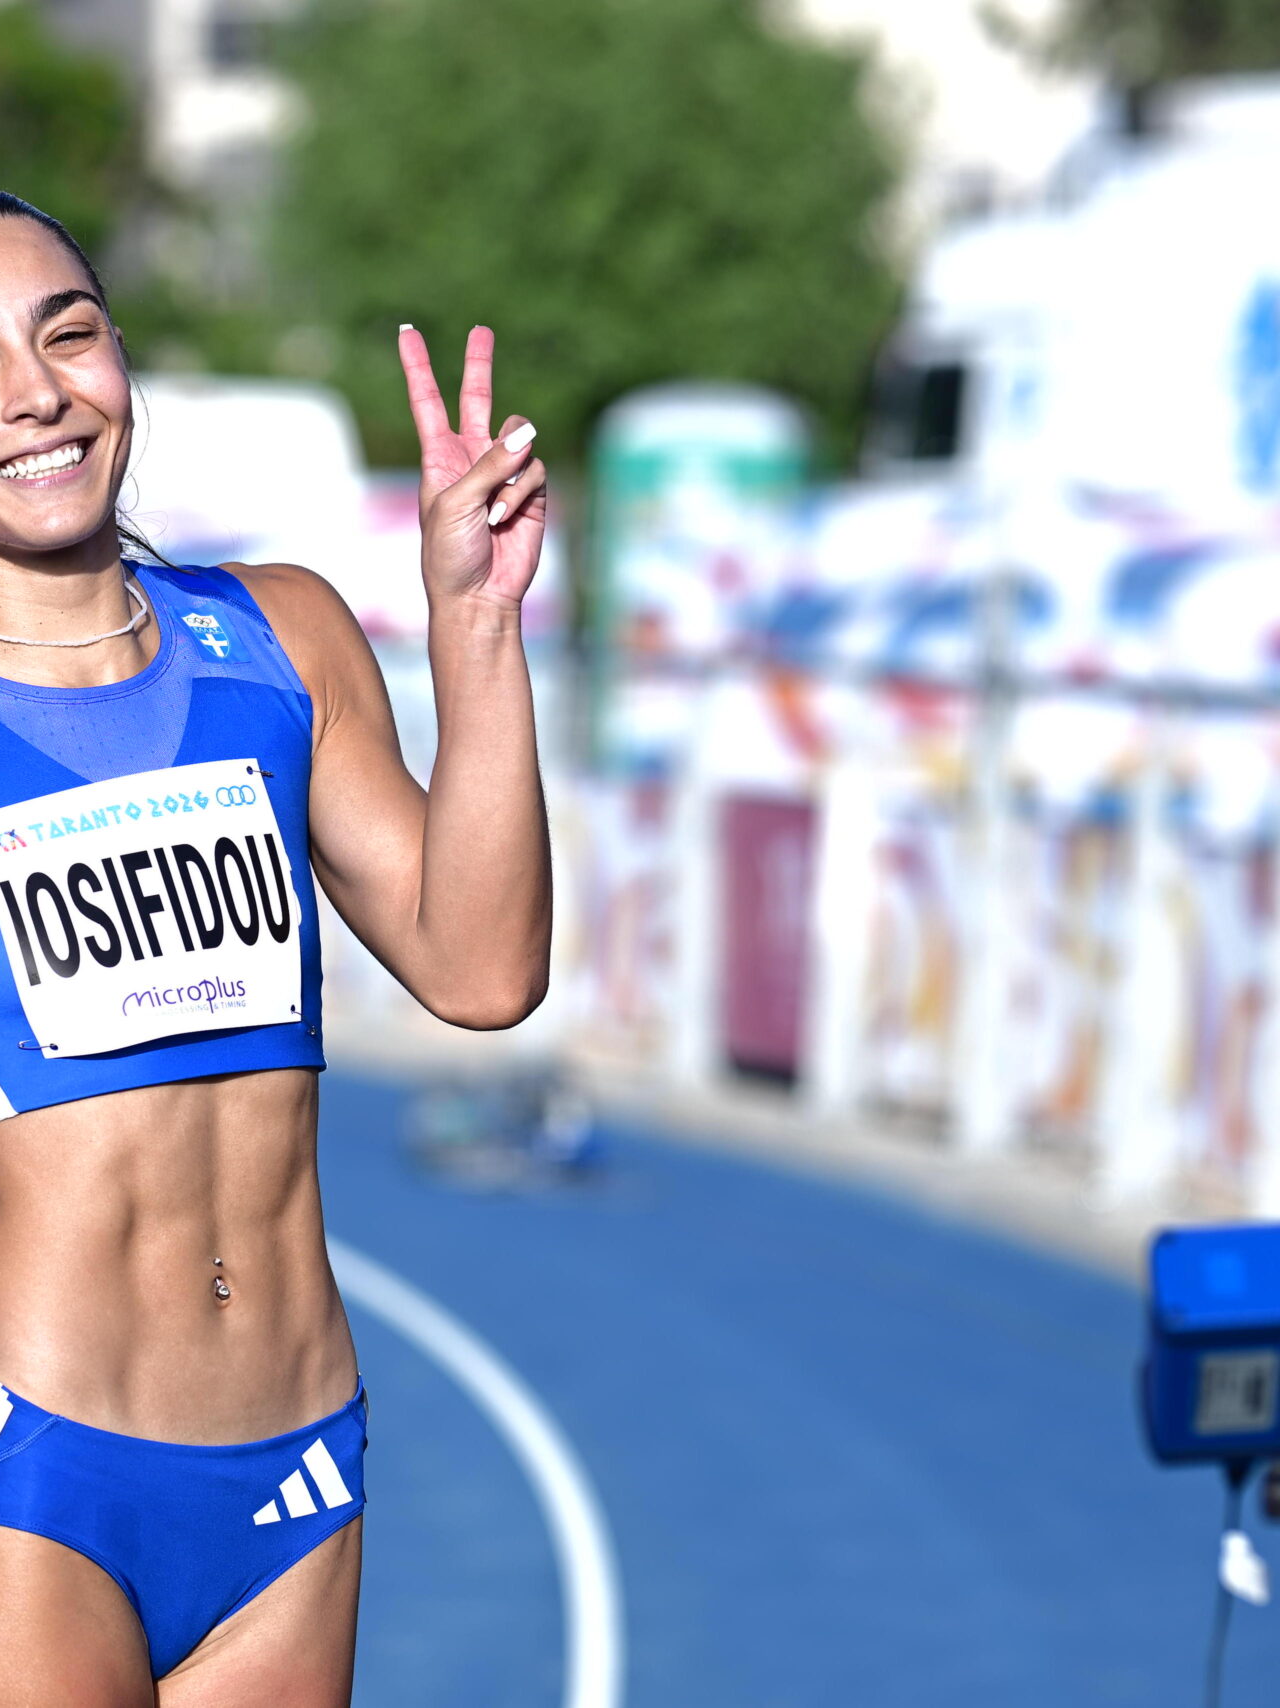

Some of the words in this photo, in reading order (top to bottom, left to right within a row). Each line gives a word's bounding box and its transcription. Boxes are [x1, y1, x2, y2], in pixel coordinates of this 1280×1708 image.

[27, 803, 141, 842] TARANTO
[147, 790, 209, 818] 2026
[0, 833, 291, 986] IOSIFIDOU
[221, 999, 247, 1009] TIMING
